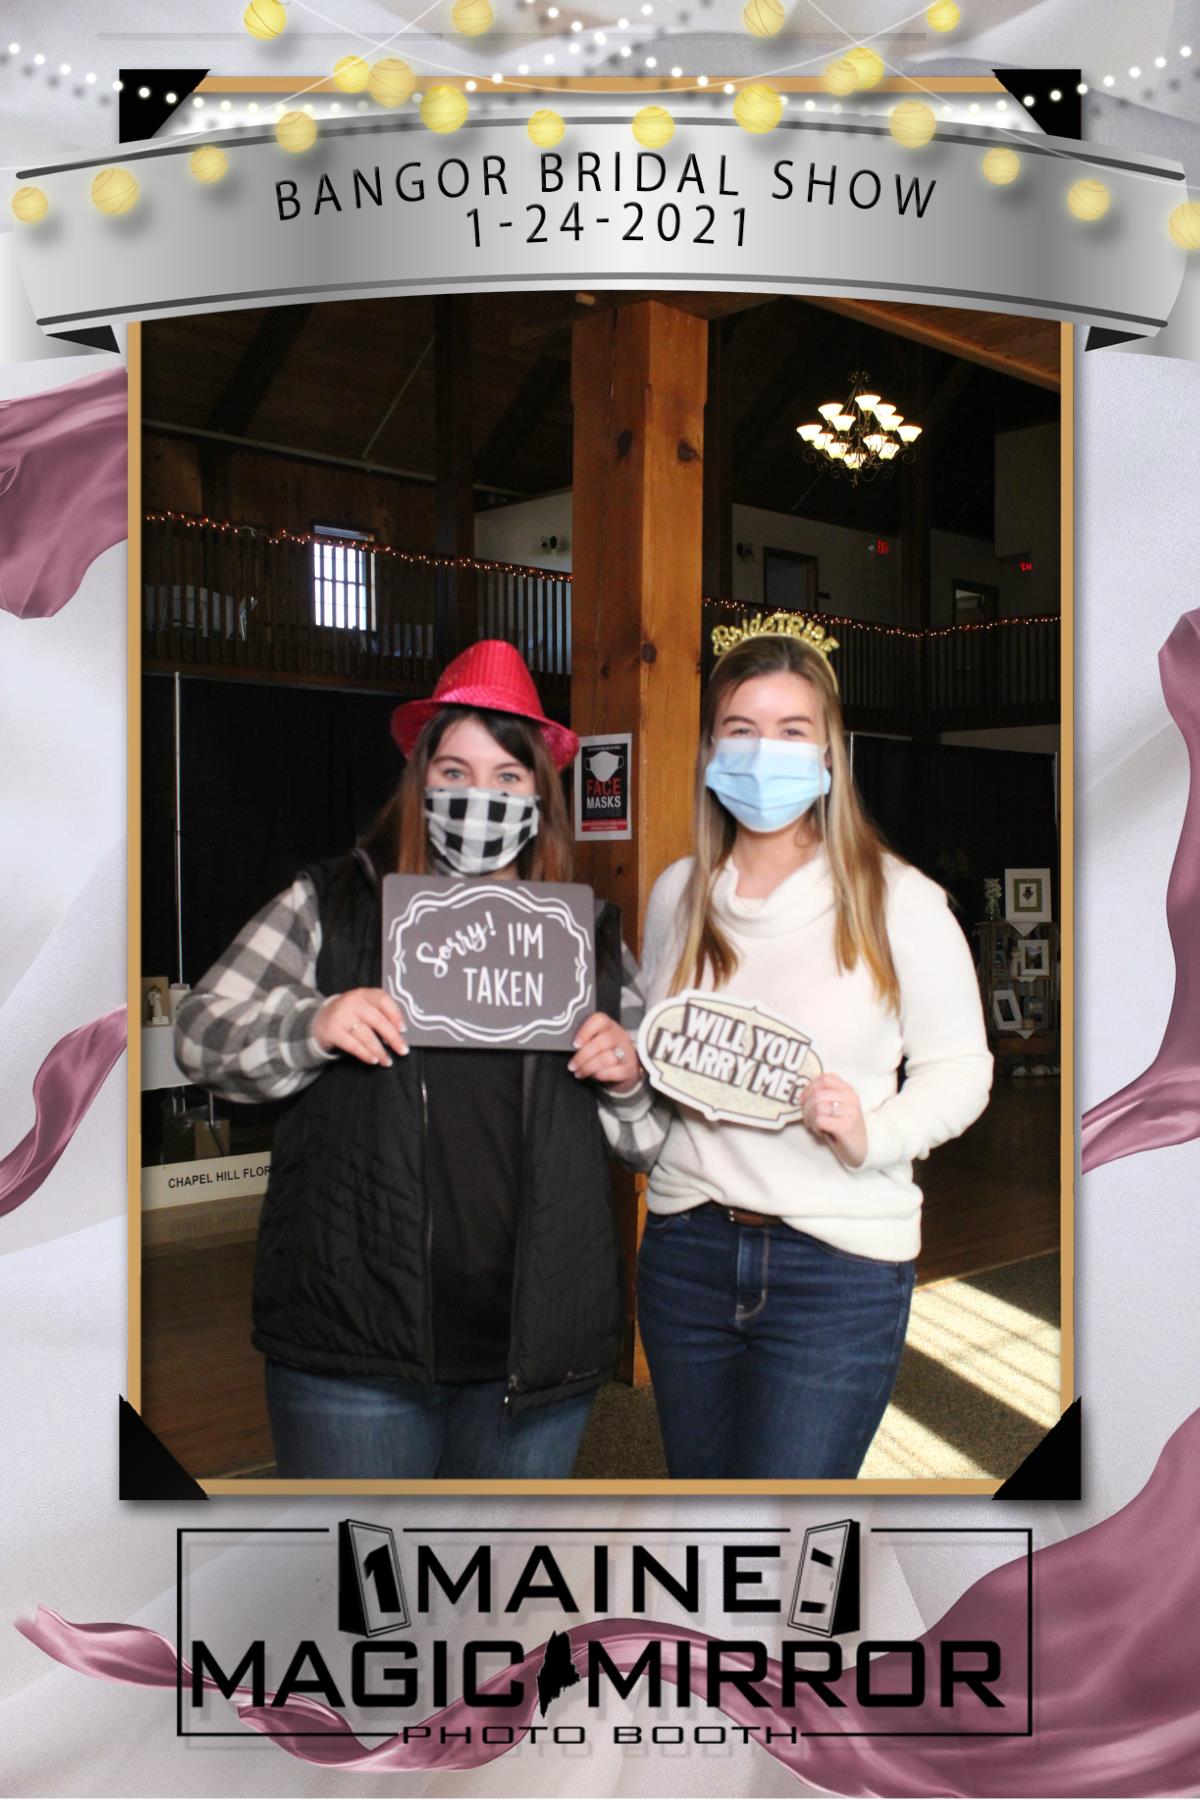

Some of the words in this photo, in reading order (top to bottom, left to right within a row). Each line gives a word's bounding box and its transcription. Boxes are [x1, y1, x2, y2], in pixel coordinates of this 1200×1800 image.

[586, 777, 622, 797] FACE
[586, 795, 622, 809] MASKS
[416, 911, 496, 978] Sorry!
[508, 922, 544, 960] I'M
[463, 966, 544, 1008] TAKEN
[651, 1029, 757, 1087] MARRY
[683, 1004, 746, 1055] WILL
[751, 1027, 810, 1072] YOU
[168, 1173, 214, 1189] CHAPEL
[216, 1170, 241, 1183] HILL
